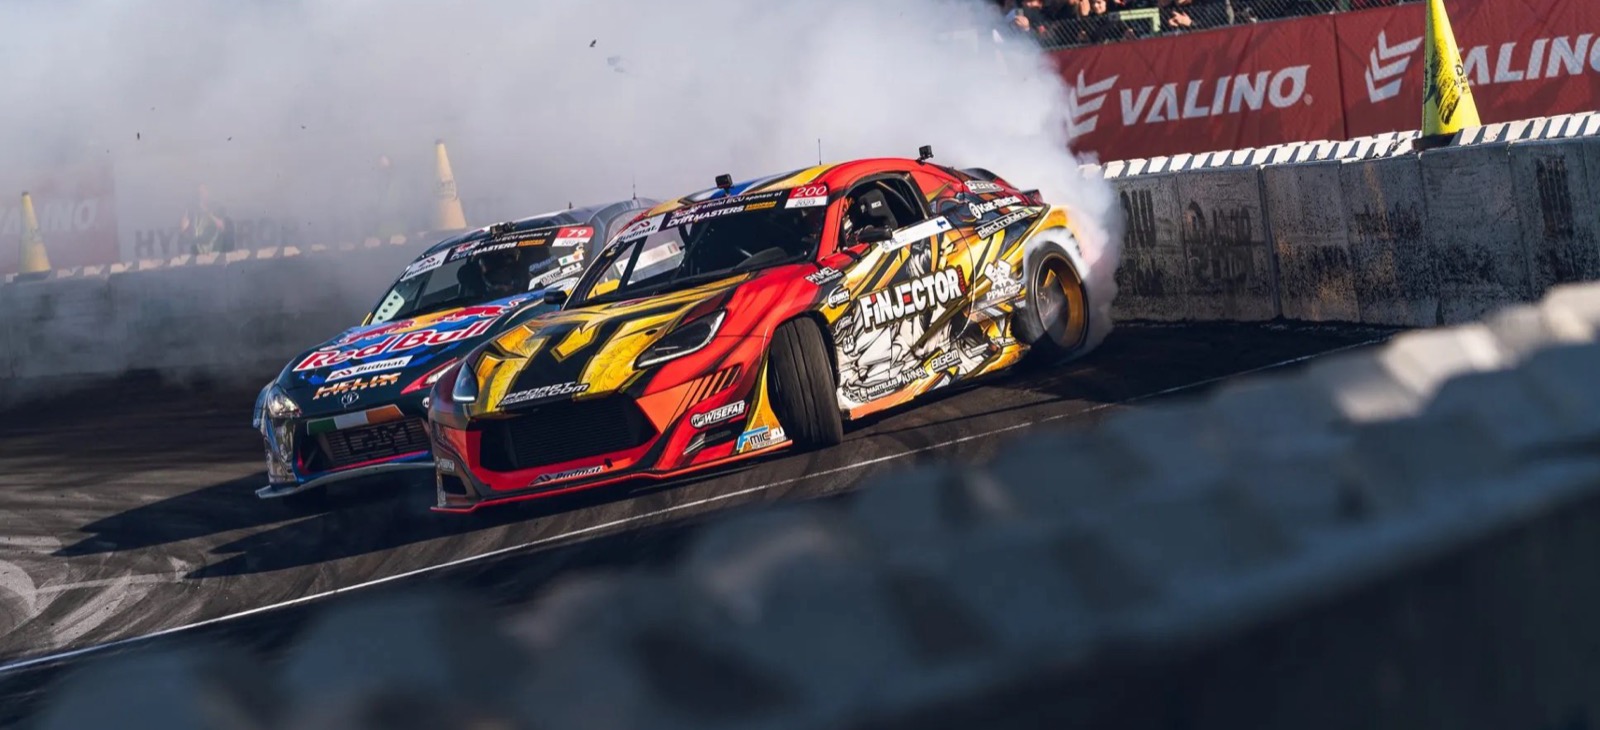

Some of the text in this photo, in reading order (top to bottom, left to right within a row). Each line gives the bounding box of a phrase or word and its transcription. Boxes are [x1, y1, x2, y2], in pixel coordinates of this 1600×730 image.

[1460, 33, 1600, 86] ALIN
[1119, 64, 1311, 126] VALINO
[726, 196, 745, 205] ECU
[774, 191, 783, 199] of
[794, 186, 827, 197] 200
[567, 228, 587, 238] 79
[293, 316, 499, 372] Red Bull
[703, 402, 745, 423] WISEFAB
